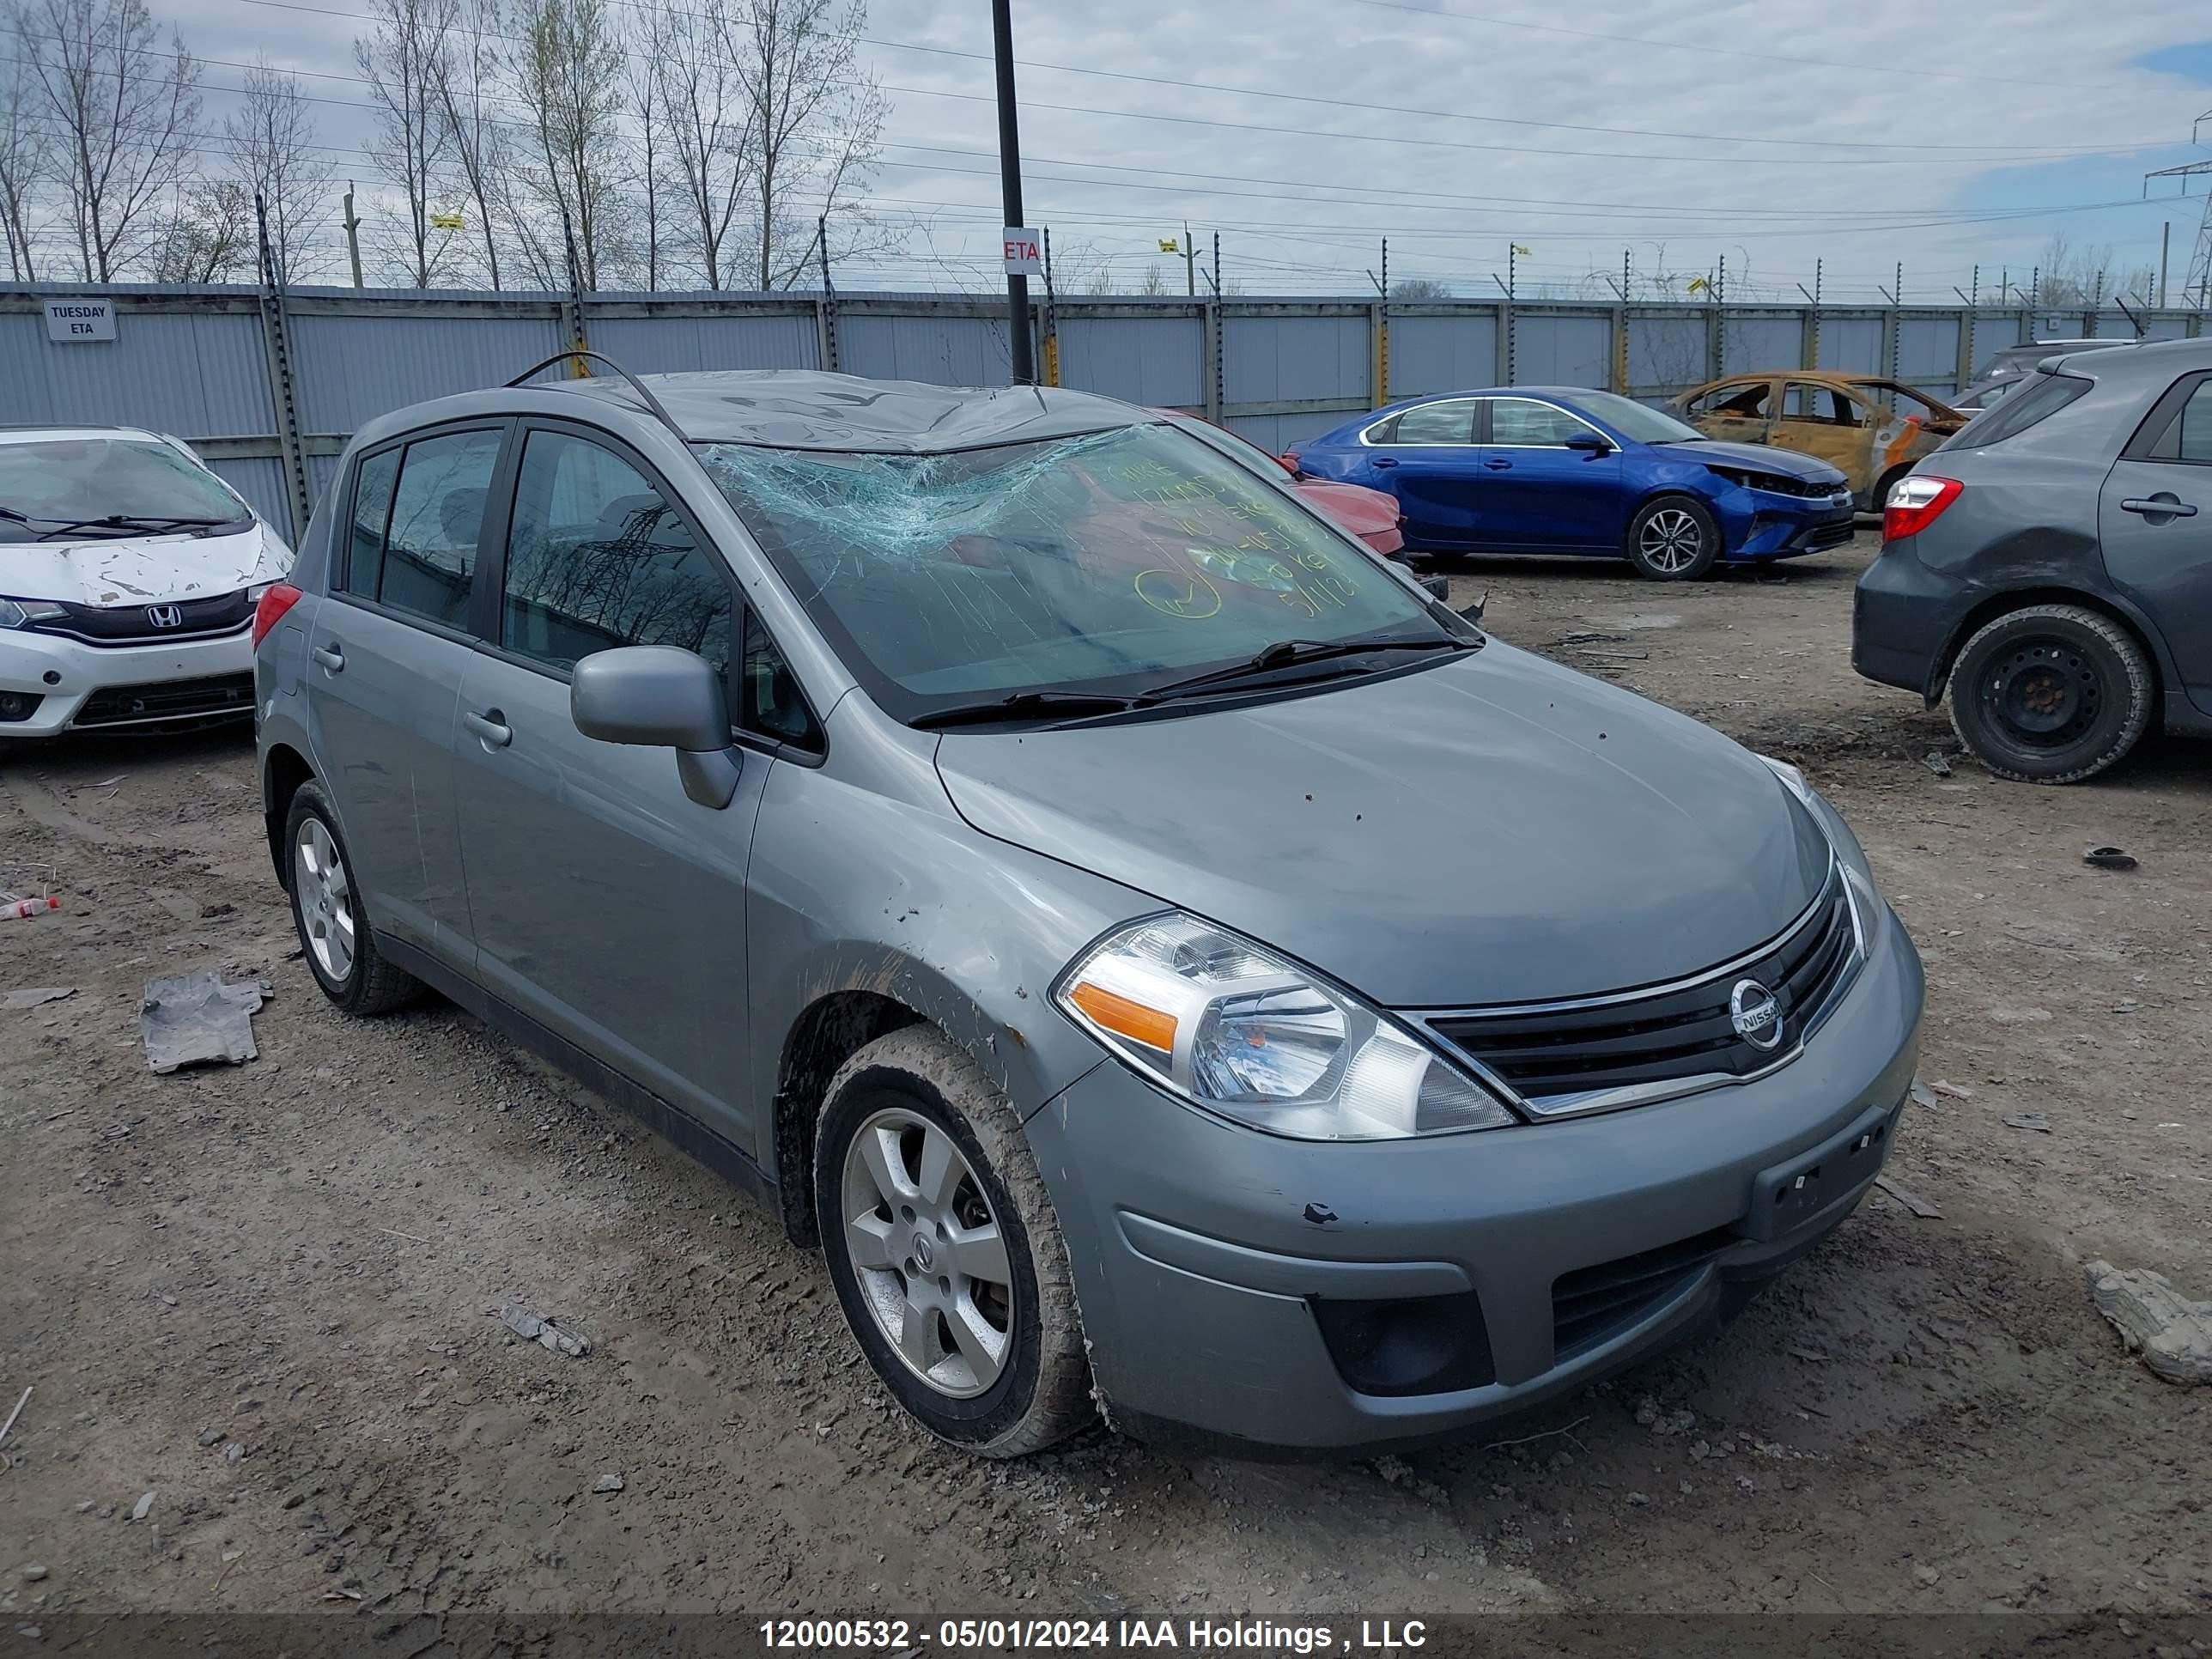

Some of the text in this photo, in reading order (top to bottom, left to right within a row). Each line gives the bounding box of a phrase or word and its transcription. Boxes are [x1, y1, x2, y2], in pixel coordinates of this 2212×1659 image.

[1005, 241, 1039, 261] ETA
[52, 307, 106, 318] TUESDAY
[70, 323, 94, 334] ETA
